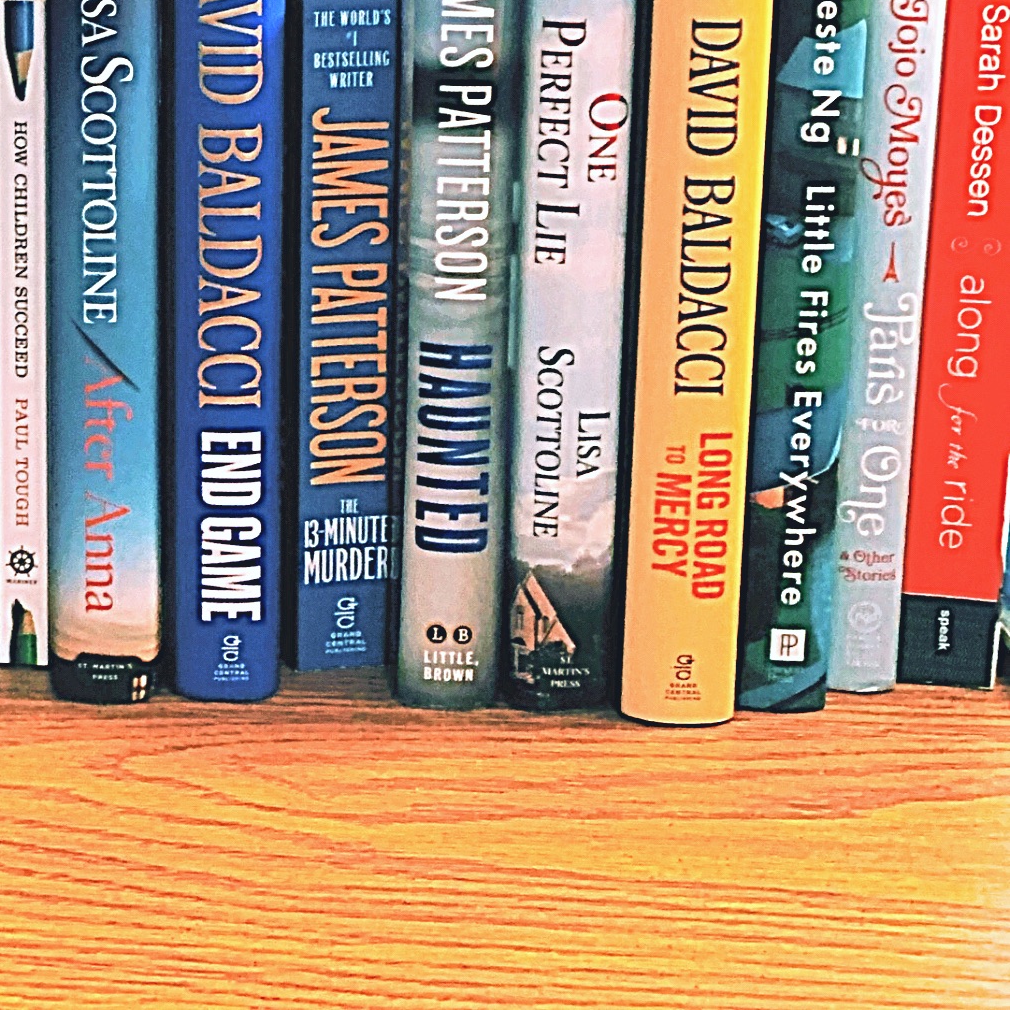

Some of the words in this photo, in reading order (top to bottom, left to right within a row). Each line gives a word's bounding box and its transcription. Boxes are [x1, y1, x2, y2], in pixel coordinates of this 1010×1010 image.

[314, 11, 335, 27] THE
[340, 8, 391, 26] WORLD'S
[978, 4, 1010, 91] Sarah
[313, 50, 390, 69] BESTSELLING
[330, 71, 374, 88] WRITER
[686, 18, 743, 157] DAVID
[14, 121, 29, 167] HOW
[537, 18, 588, 189] PERFECT
[587, 93, 628, 183] ONE
[801, 89, 842, 144] Ng
[81, 56, 134, 324] SCOTTOLINE
[311, 107, 390, 248] JAMES
[434, 85, 493, 301] PATTERSON
[860, 84, 922, 228] Moyes
[966, 105, 1003, 217] Dessen
[14, 173, 29, 278] CHILDREN
[197, 123, 262, 409] BALDACCI
[534, 200, 581, 266] LIE
[801, 186, 835, 274] Little
[674, 176, 736, 397] BALDACCI
[947, 275, 992, 377] along
[14, 287, 30, 378] SUCCEED
[795, 290, 829, 375] Fires
[864, 292, 919, 405] Paris
[309, 262, 389, 486] PATTERSON
[937, 382, 978, 436] for
[15, 398, 29, 451] PAUL
[84, 356, 133, 481] After
[415, 342, 493, 553] HAUNTED
[533, 345, 575, 538] SCOTTOLINE
[576, 410, 611, 479] LISA
[665, 445, 686, 465] TO
[947, 442, 967, 469] the
[15, 458, 30, 526] TOUGH
[201, 431, 262, 507] END
[340, 498, 359, 514] THE
[696, 432, 733, 510] LONG
[779, 391, 823, 606] Everywhere
[841, 446, 901, 537] One
[84, 491, 130, 613] Anna
[304, 515, 388, 548] 13-MINUTE
[651, 472, 692, 577] MERCY
[939, 479, 973, 550] ride
[201, 516, 262, 622] GAME
[304, 546, 388, 585] MURDER
[692, 519, 728, 600] ROAD
[839, 566, 896, 582] Stories
[853, 550, 895, 566] Other
[325, 639, 367, 648] CENTRAL
[423, 651, 479, 667] LITTLE,
[938, 609, 950, 651] speak
[423, 667, 474, 681] BROWN
[542, 667, 590, 676] MARTIN'S
[551, 679, 581, 688] PRESS
